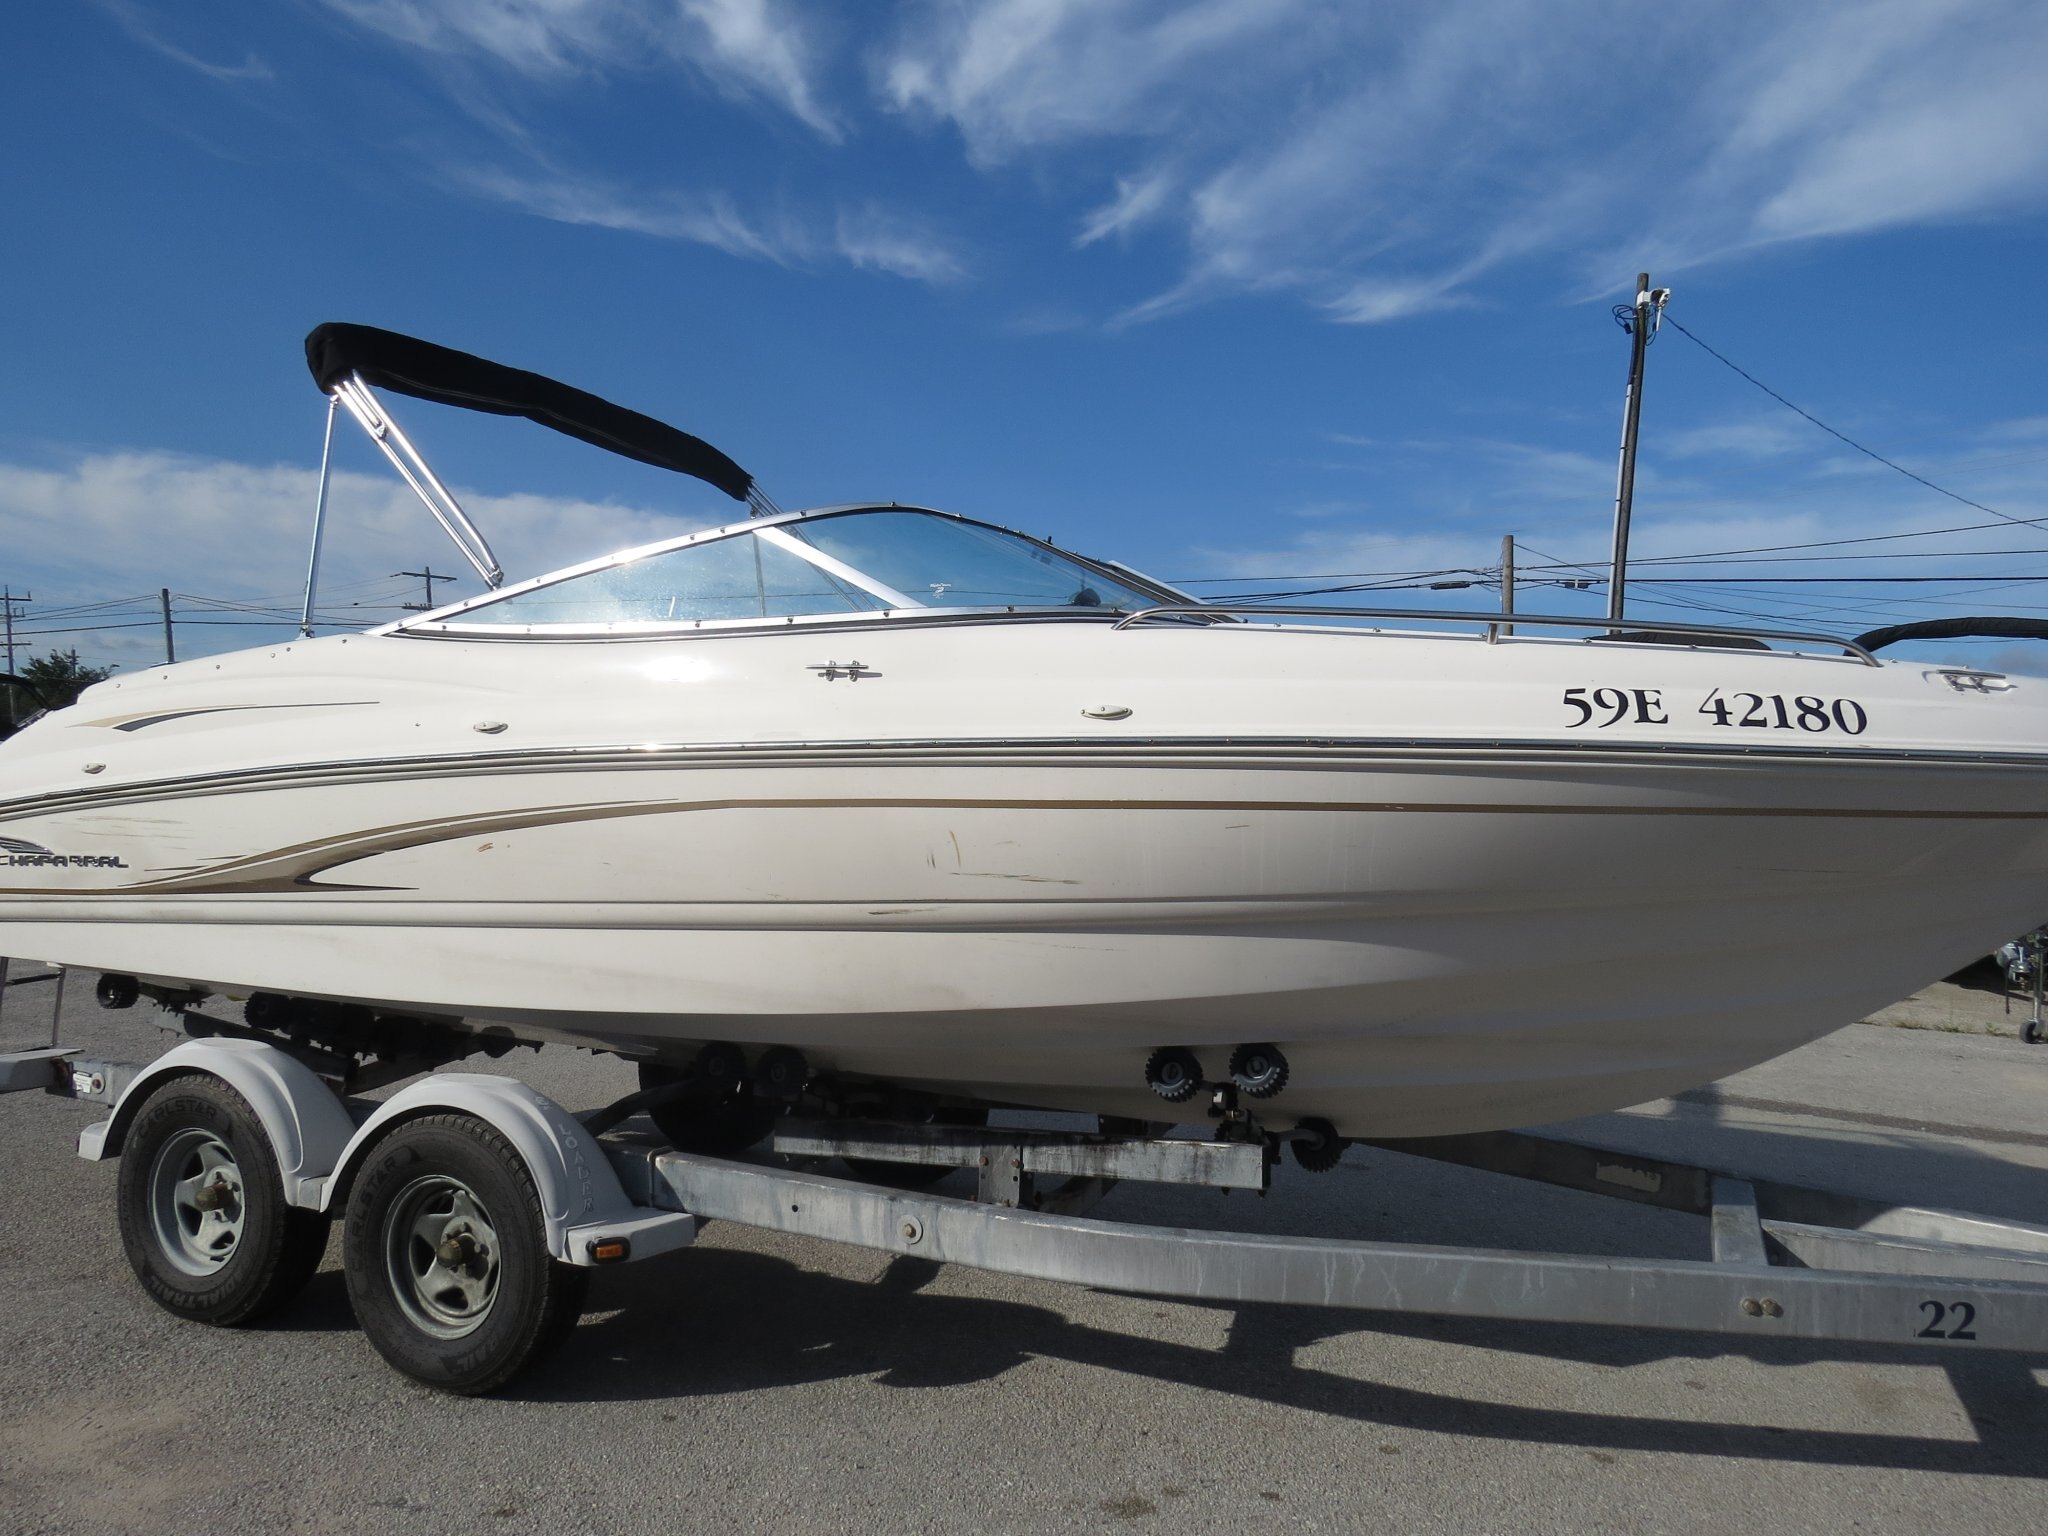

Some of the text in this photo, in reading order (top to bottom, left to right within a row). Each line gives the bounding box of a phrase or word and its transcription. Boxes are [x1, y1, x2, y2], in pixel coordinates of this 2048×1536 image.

[1563, 688, 1867, 735] 59E 42180
[1918, 1300, 1976, 1340] 22
